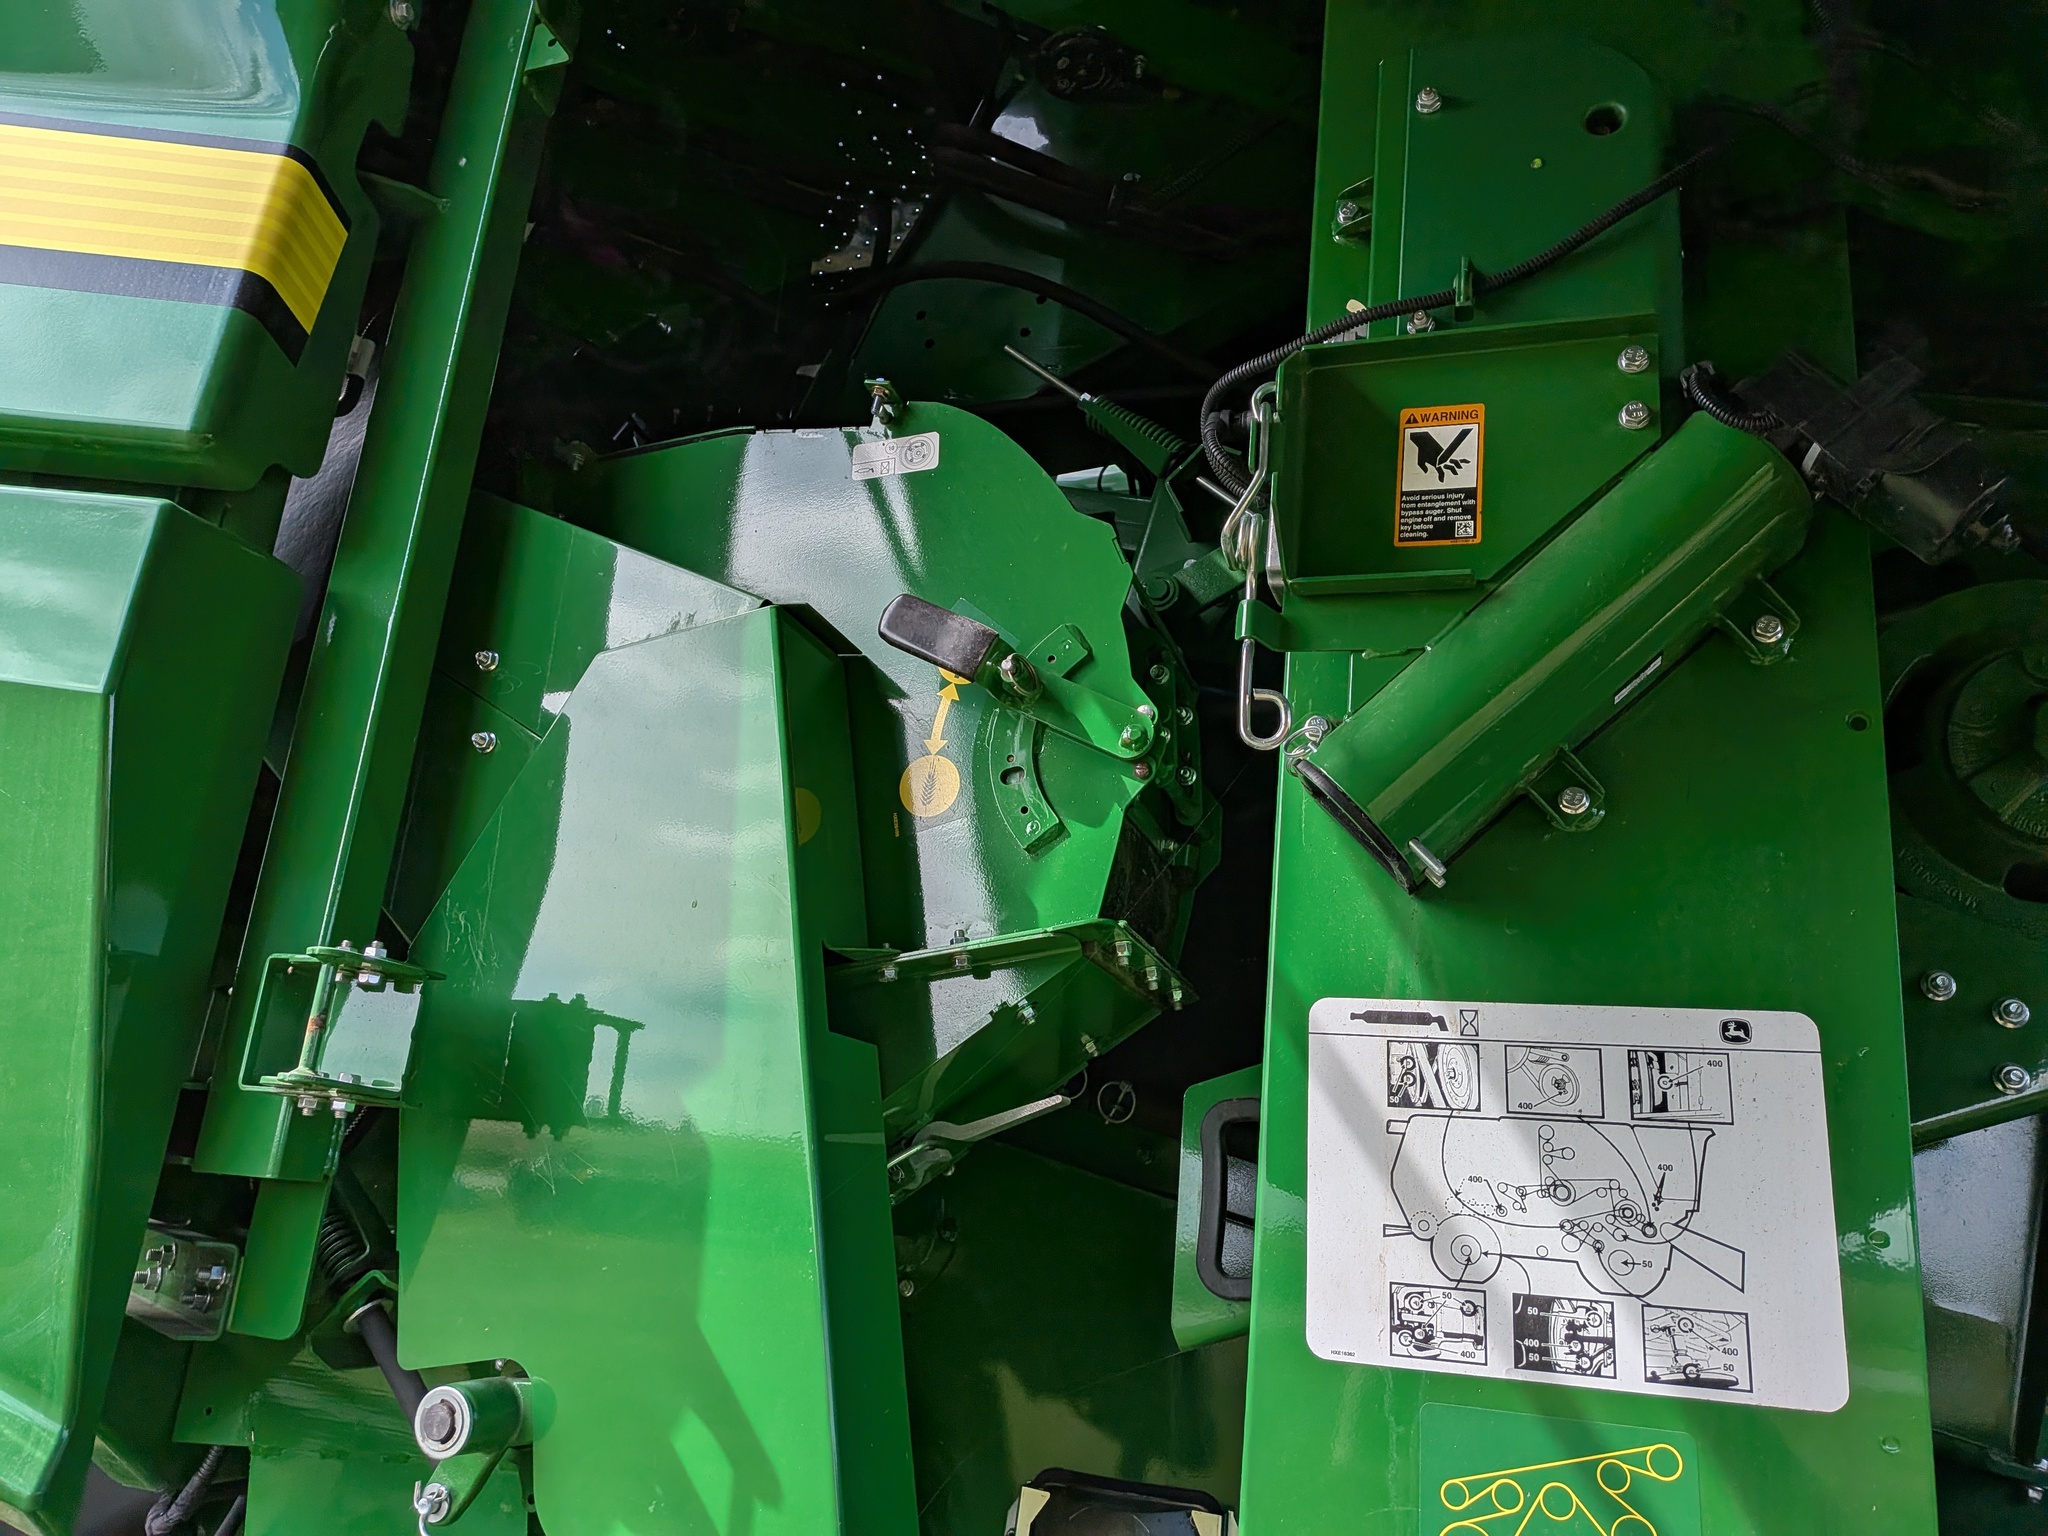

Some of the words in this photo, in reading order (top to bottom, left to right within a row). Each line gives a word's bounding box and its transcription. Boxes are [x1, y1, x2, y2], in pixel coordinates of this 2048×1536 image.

[1420, 409, 1479, 423] WARNING
[1446, 492, 1465, 500] injury
[1417, 500, 1461, 508] entanglement
[1706, 1060, 1723, 1068] 400
[1517, 1102, 1533, 1110] 400
[1657, 1163, 1674, 1172] 400
[1641, 1260, 1653, 1268] 50
[1442, 1291, 1452, 1299] 50
[1527, 1306, 1538, 1315] 50
[1523, 1338, 1540, 1347] 400
[1460, 1350, 1476, 1359] 400
[1721, 1347, 1739, 1356] 400
[1528, 1353, 1540, 1362] 50
[1723, 1363, 1735, 1372] 50
